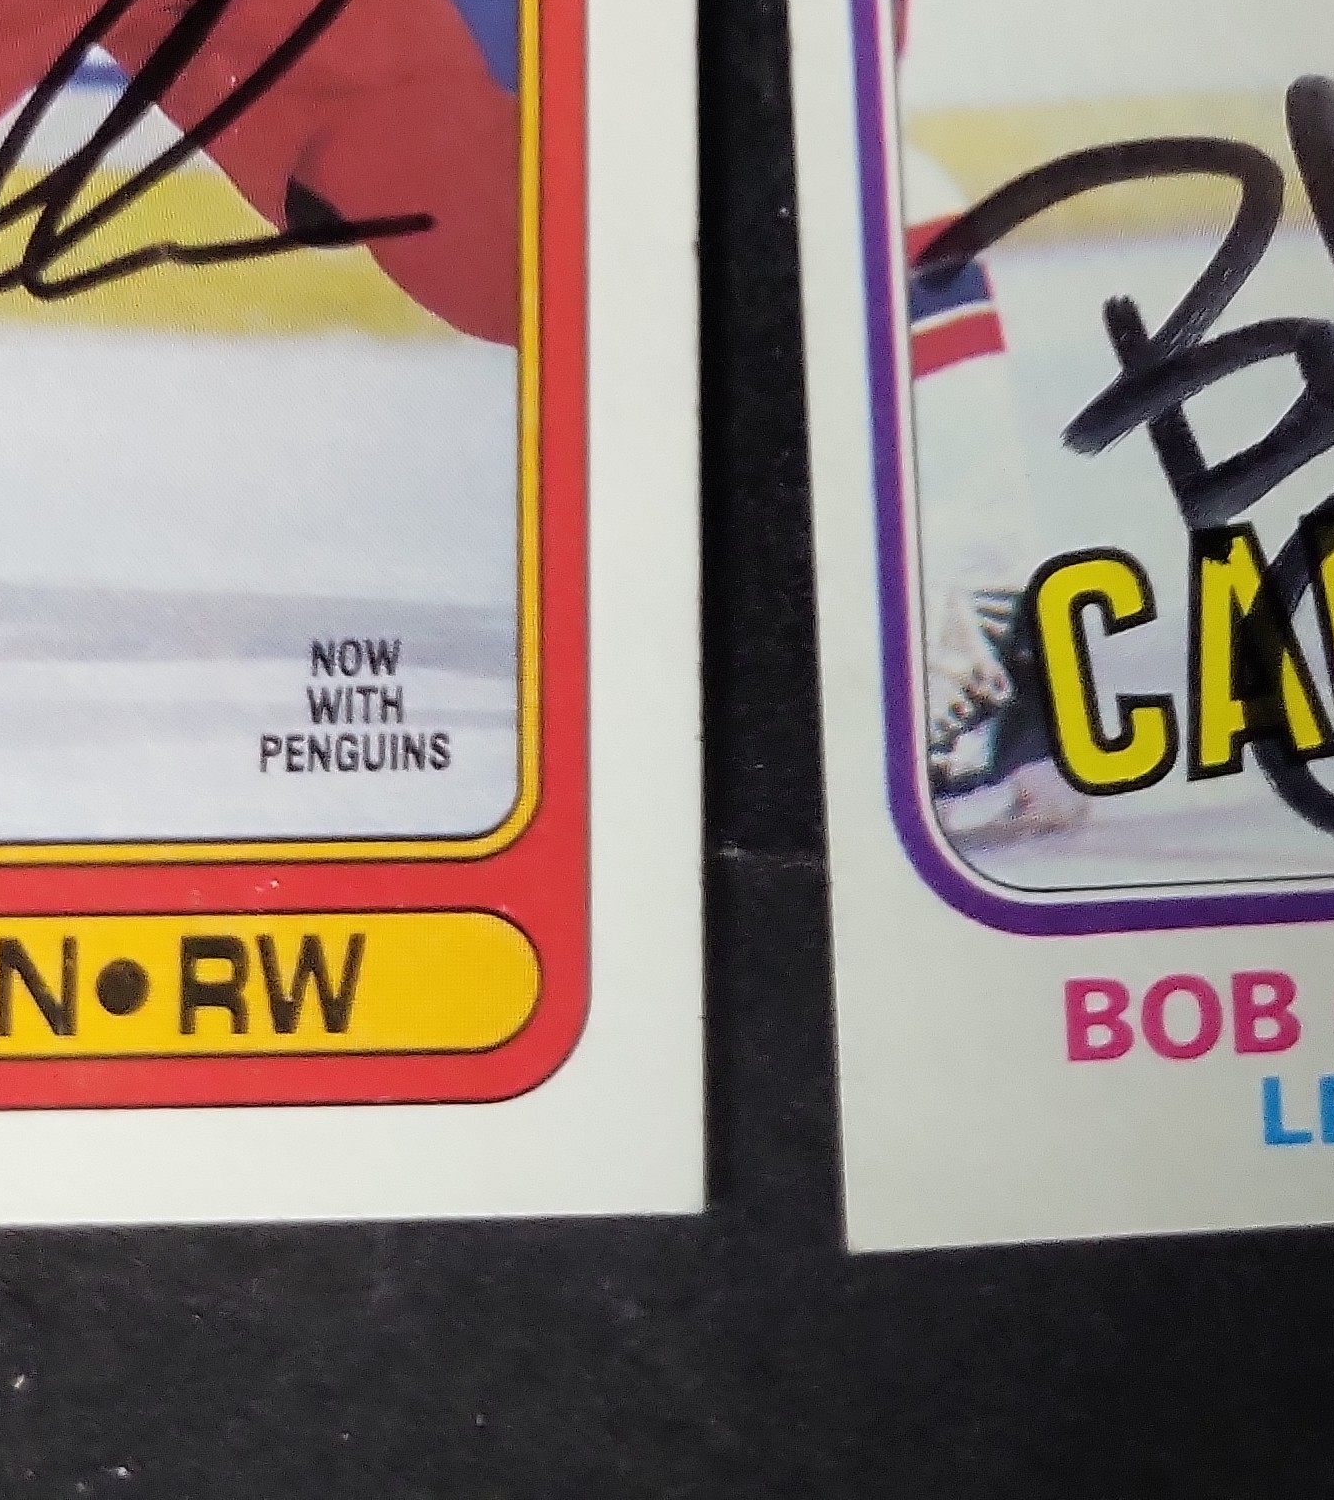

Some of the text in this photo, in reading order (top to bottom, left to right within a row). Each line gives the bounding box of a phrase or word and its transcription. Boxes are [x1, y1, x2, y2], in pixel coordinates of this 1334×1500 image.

[309, 638, 403, 678] NOW
[307, 686, 405, 725] WITH
[259, 733, 452, 774] PENGUINS
[178, 933, 367, 1036] RW
[1064, 968, 1303, 1063] BOB
